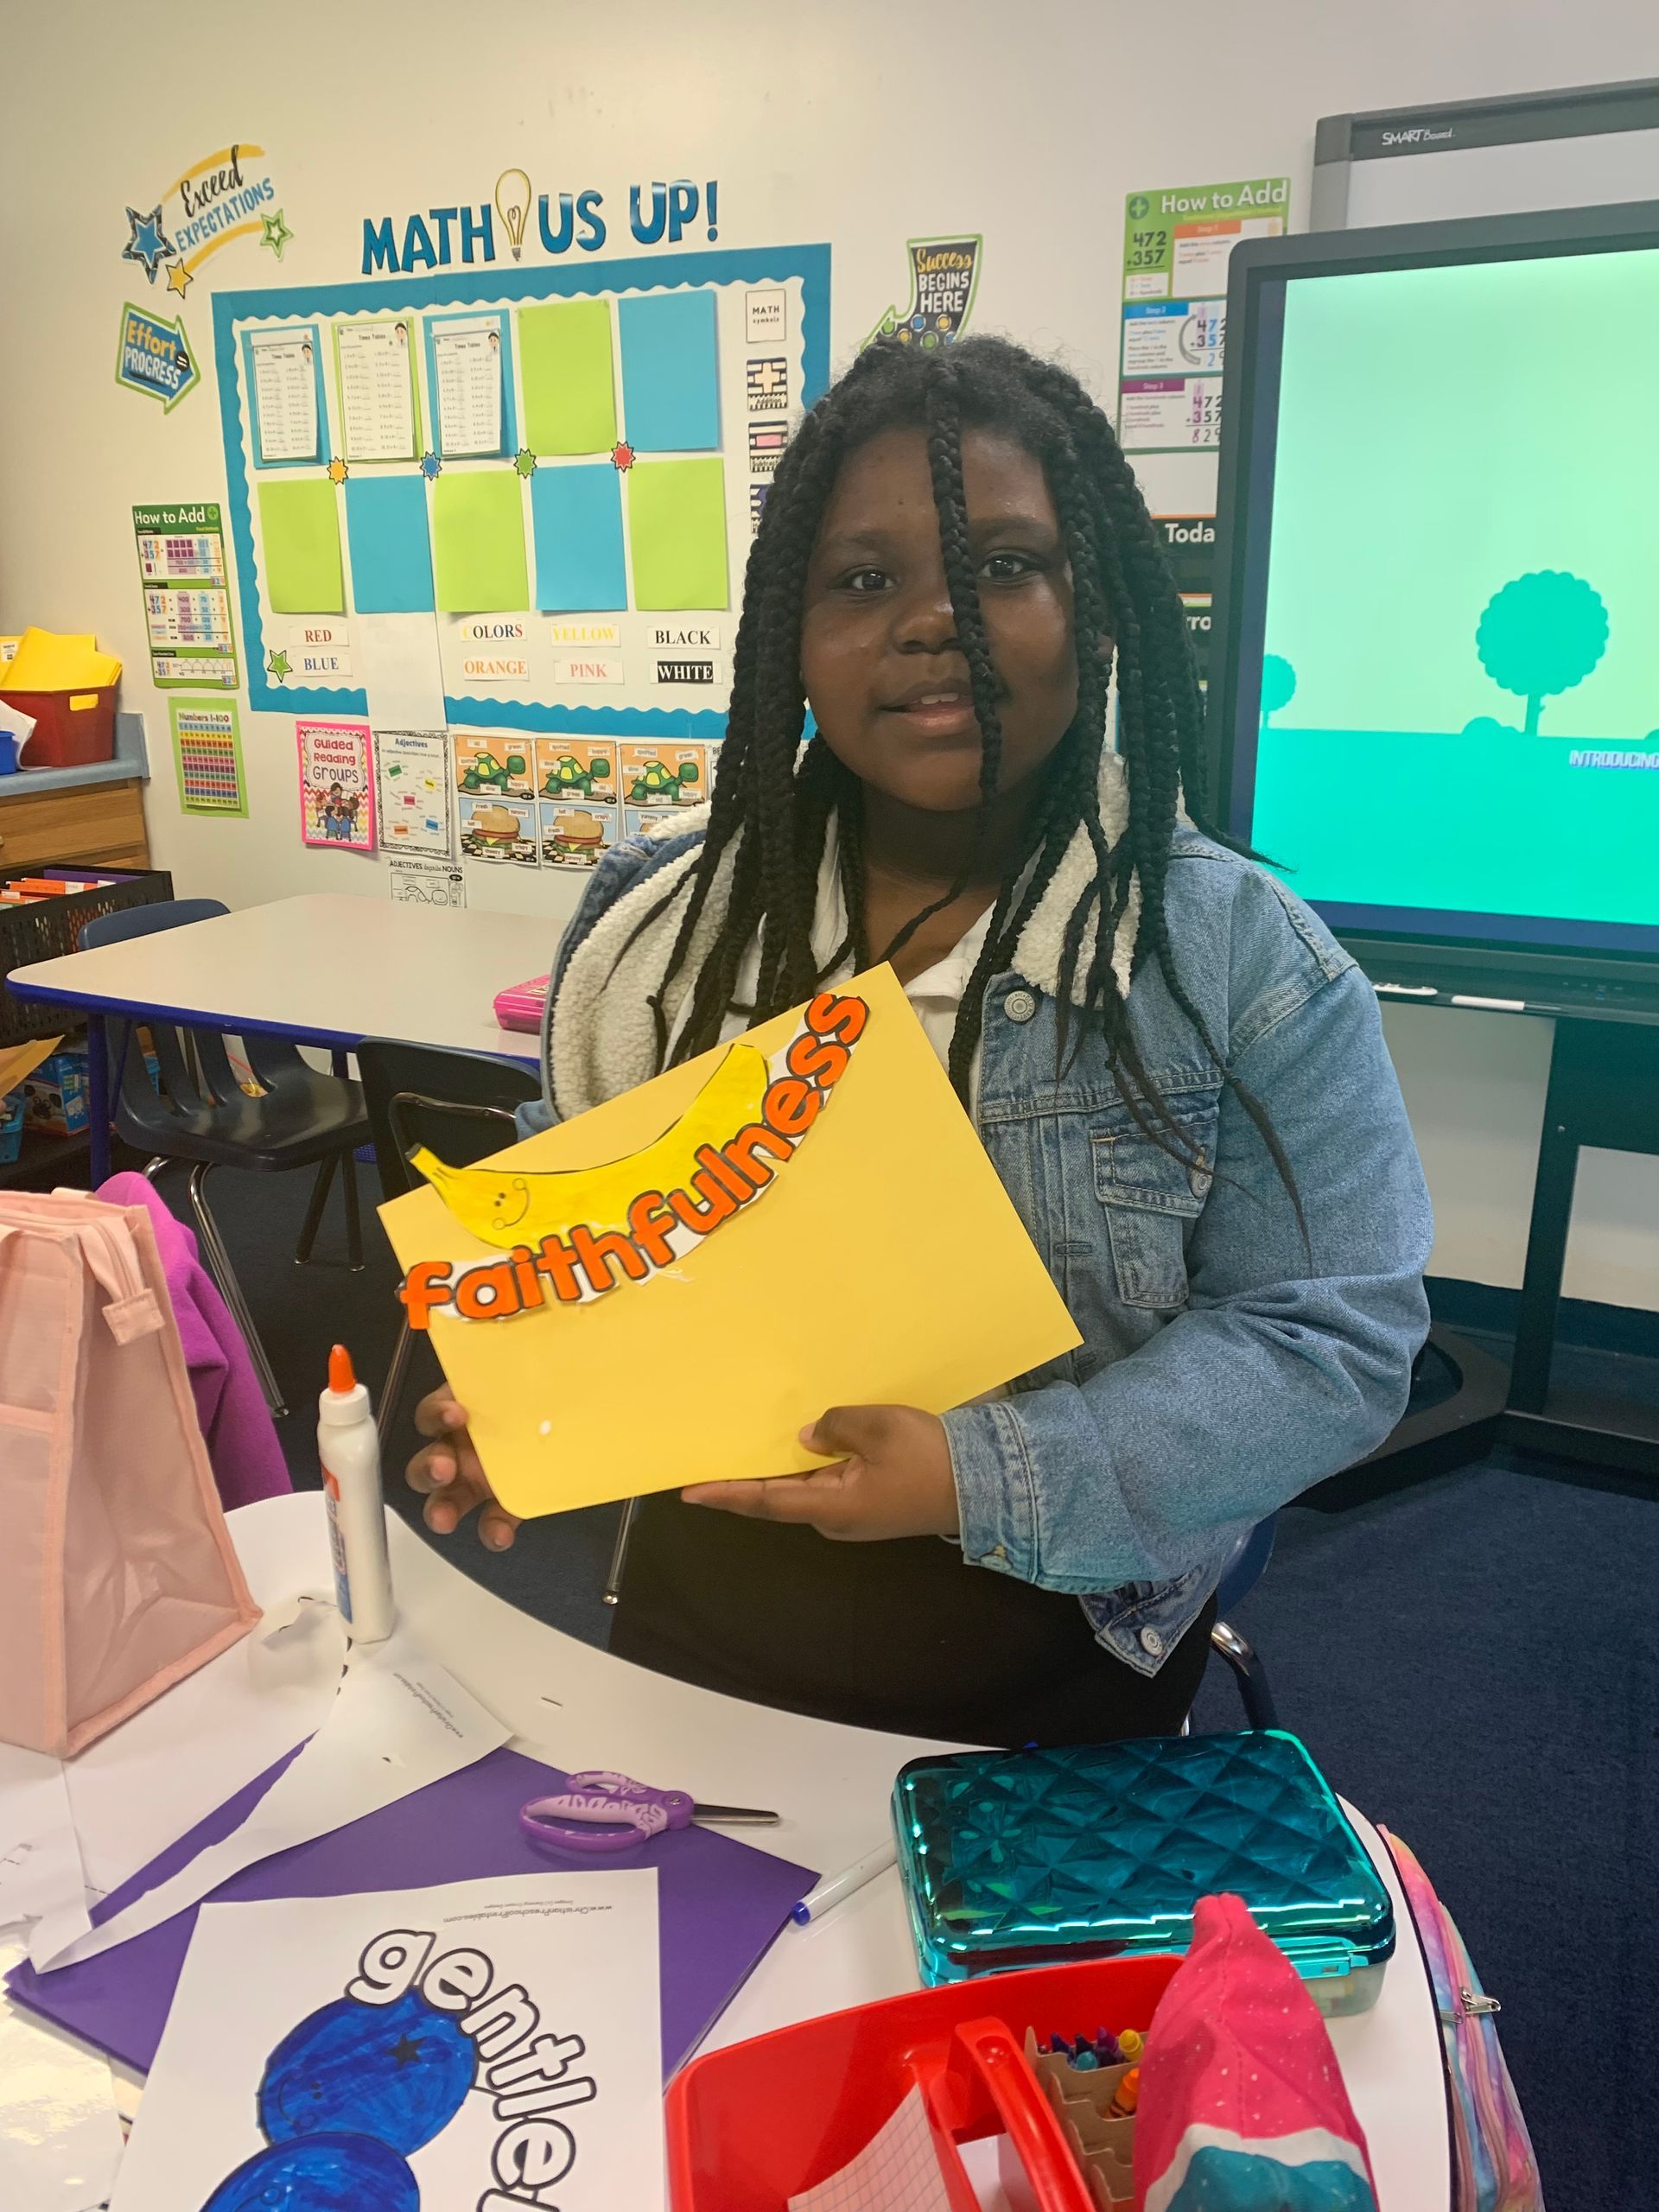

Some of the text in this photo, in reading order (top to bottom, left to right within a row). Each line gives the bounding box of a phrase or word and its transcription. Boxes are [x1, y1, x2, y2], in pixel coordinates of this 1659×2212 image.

[1382, 129, 1425, 145] SMART
[180, 144, 244, 218] Exceed
[1161, 180, 1287, 213] How to Add
[175, 177, 275, 252] EXPECTATIONS
[361, 180, 718, 276] MATH US UP!
[1134, 231, 1166, 247] 472
[917, 248, 973, 273] Success
[918, 271, 969, 292] BEGINS
[920, 290, 963, 313] HERE
[753, 306, 779, 315] MATH
[127, 320, 175, 360] Effort
[124, 346, 181, 389] PROGRESS
[134, 505, 206, 524] How to Add
[1165, 521, 1216, 543] Toda
[305, 629, 332, 643] RED
[462, 624, 524, 639] COLORS
[553, 627, 614, 641] YELLOW
[655, 630, 711, 645] BLACK
[303, 658, 339, 671] BLUE
[464, 660, 526, 675] ORANGE
[570, 664, 607, 677] PINK
[658, 664, 713, 680] WHITE
[179, 712, 229, 722] Numbers 1-100
[314, 739, 353, 750] Guided
[395, 738, 428, 747] Adjectives
[314, 753, 356, 766] Reading
[313, 766, 359, 783] Groups
[390, 861, 423, 870] ADJECTIVES
[442, 865, 463, 874] NOUNS
[399, 992, 870, 1330] faithfulness
[443, 1904, 613, 1923] www.ChristianPreschoolPrintables.com
